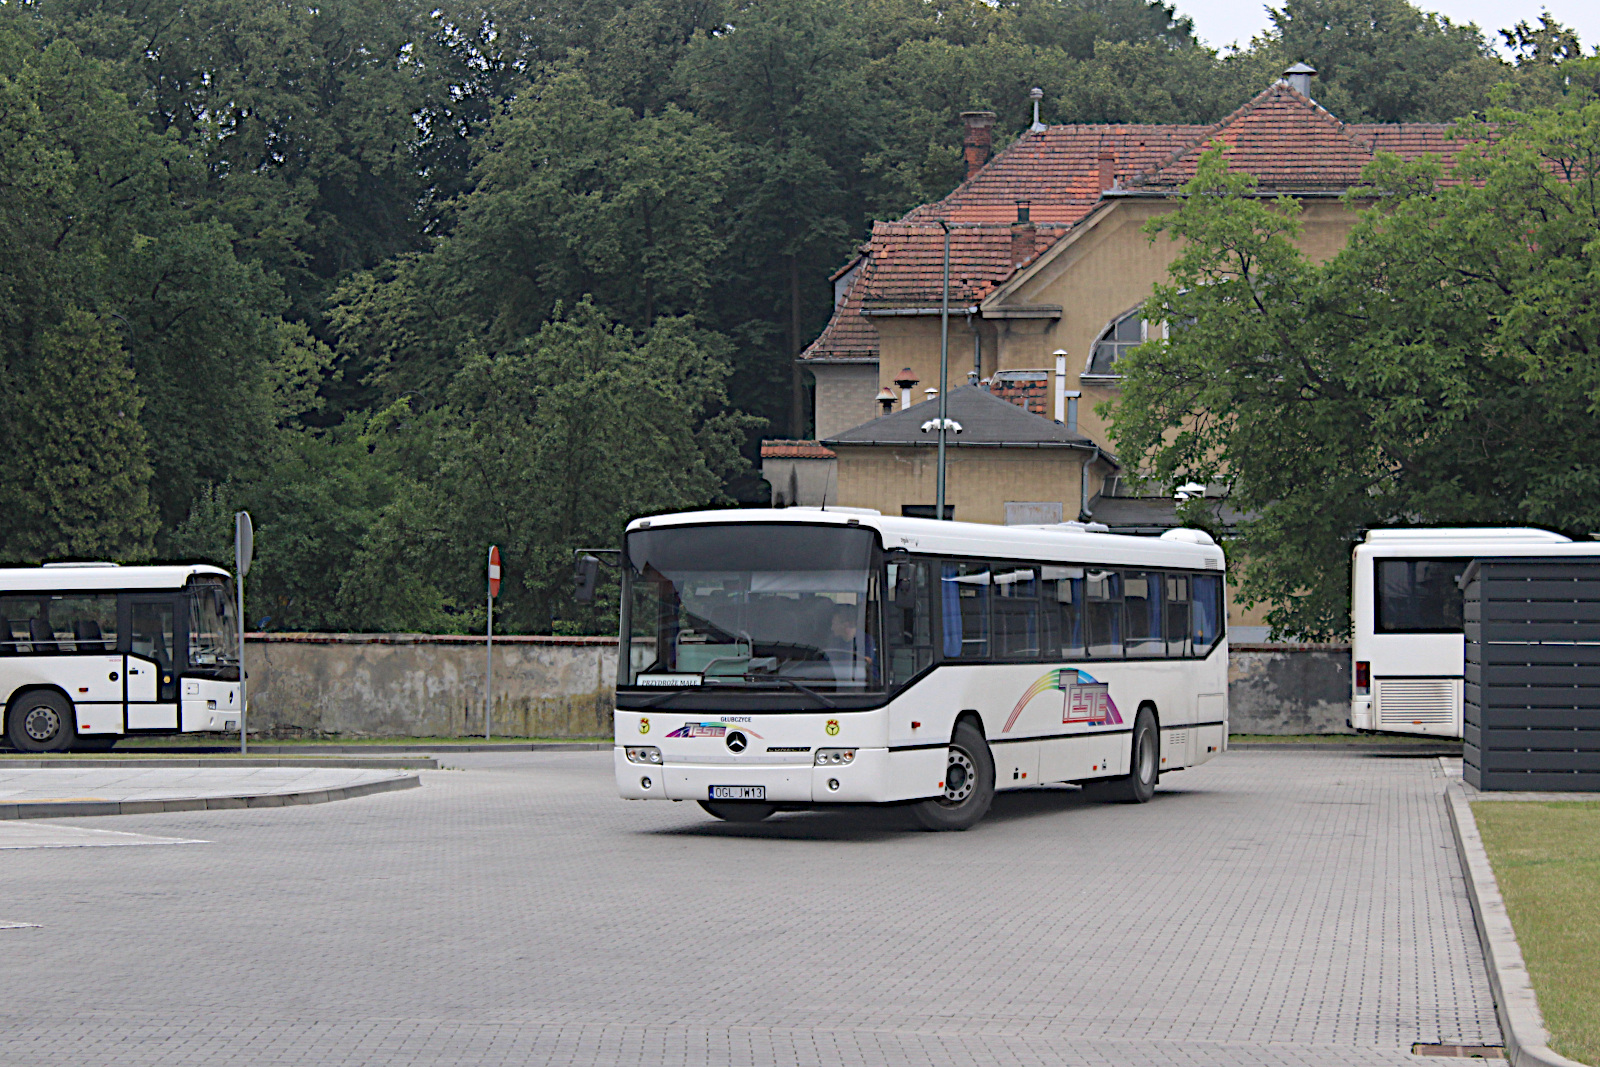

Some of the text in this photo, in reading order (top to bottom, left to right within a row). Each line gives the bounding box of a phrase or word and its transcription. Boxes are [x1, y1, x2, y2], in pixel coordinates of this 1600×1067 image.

[641, 678, 679, 686] PRZYDROŻE
[1058, 669, 1109, 724] TESTE
[685, 722, 727, 738] TESTE
[715, 787, 735, 798] OGL
[738, 787, 762, 798] JW13
